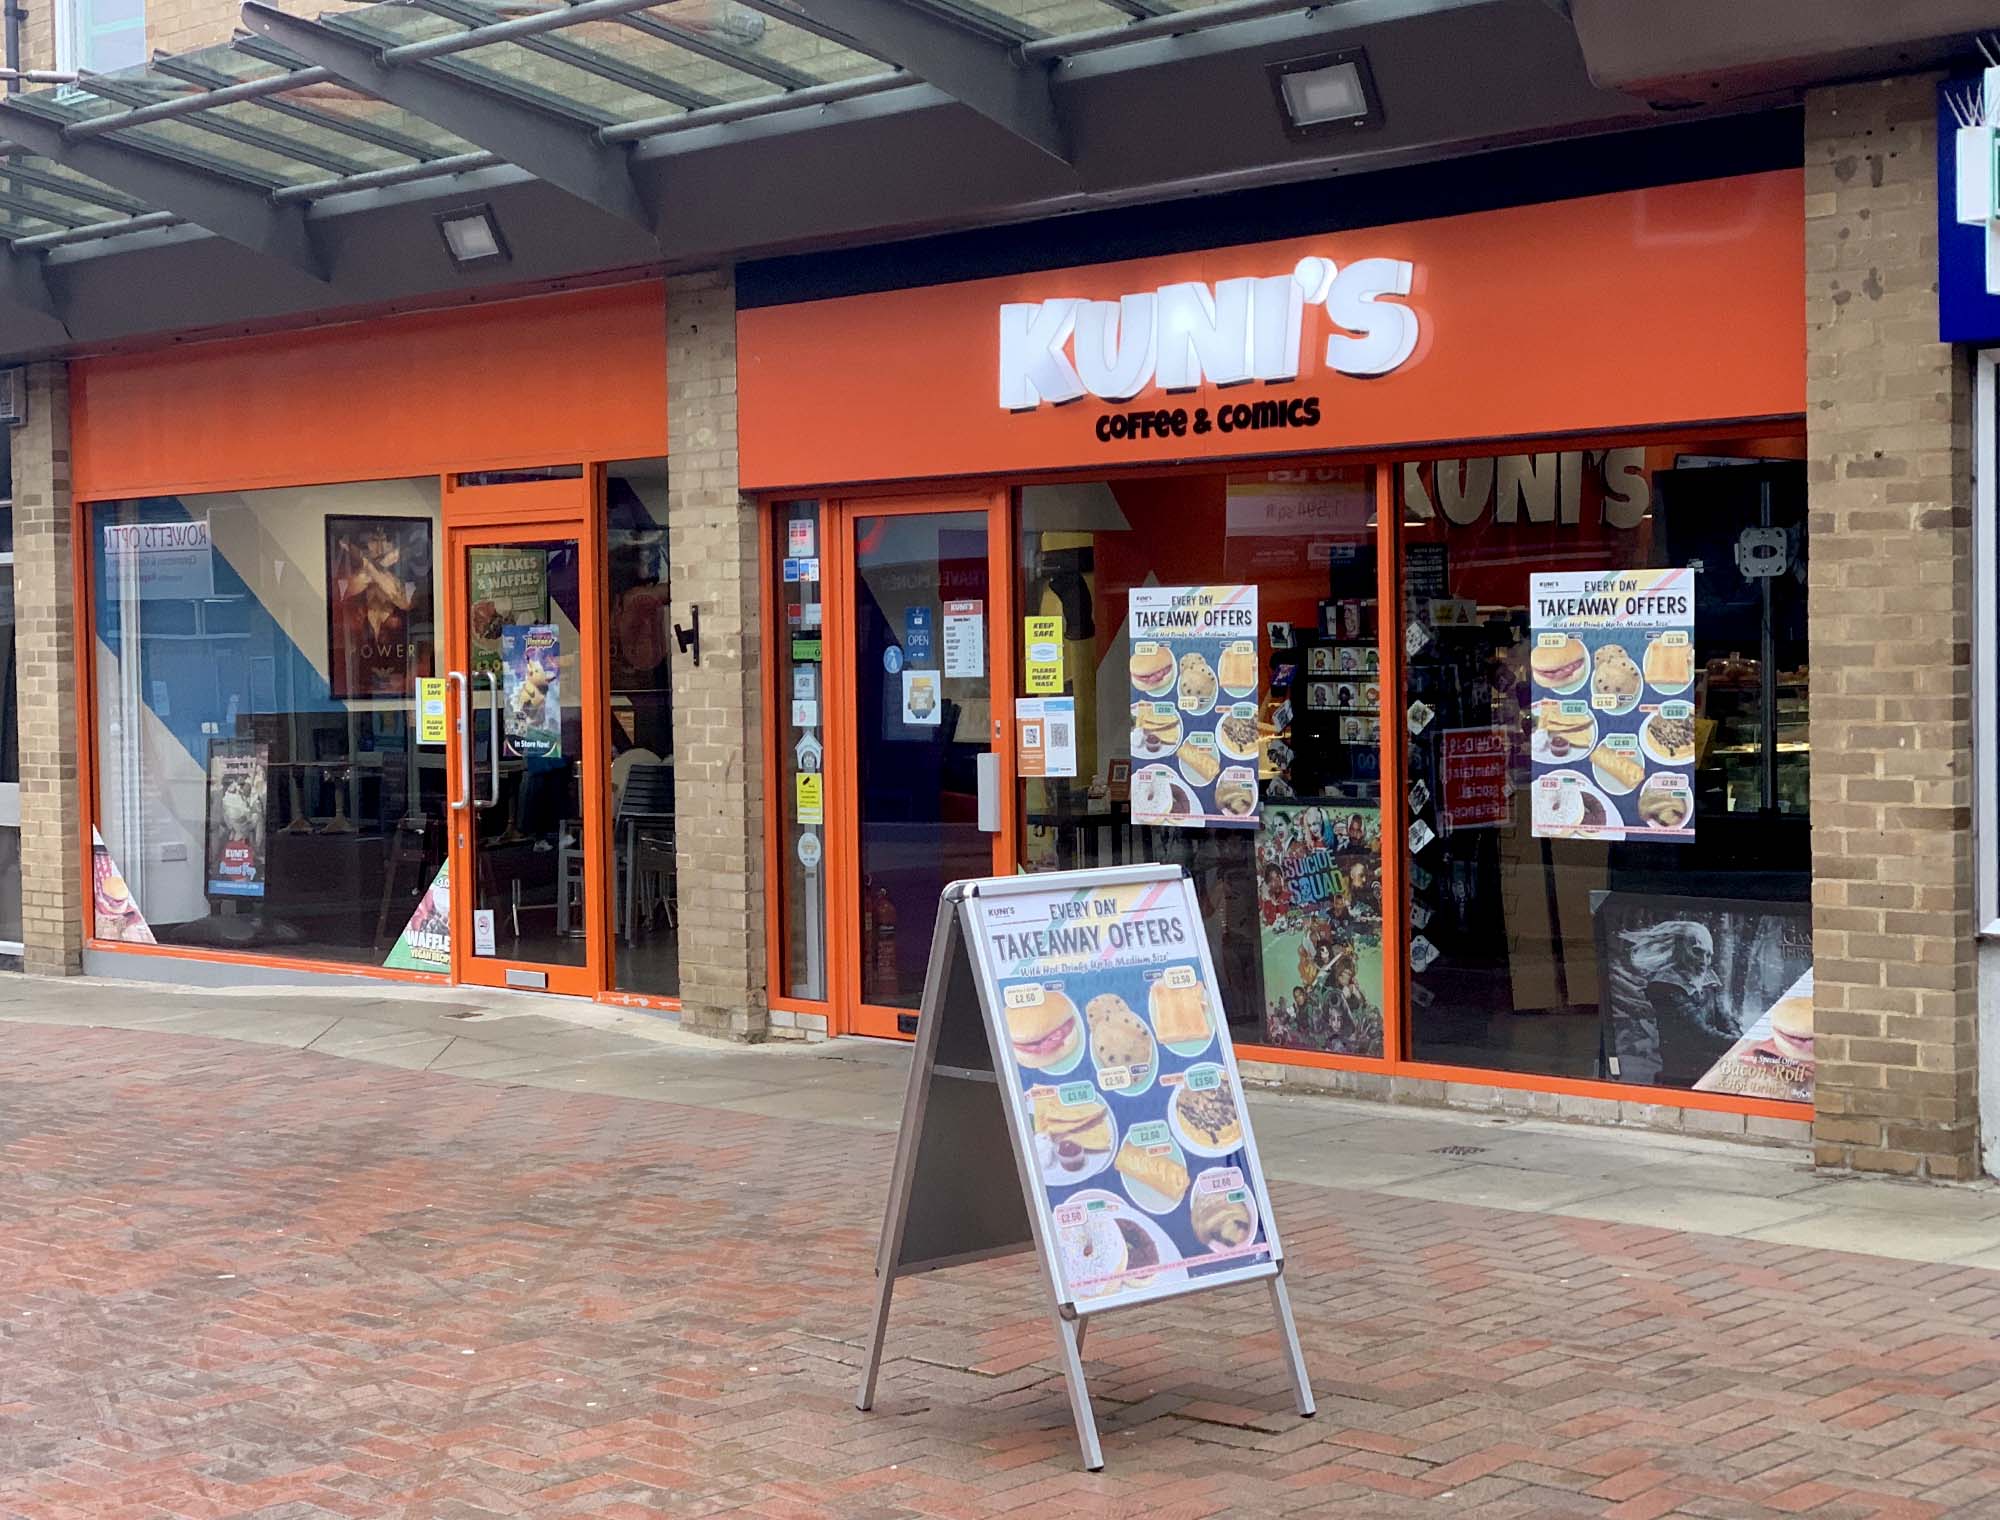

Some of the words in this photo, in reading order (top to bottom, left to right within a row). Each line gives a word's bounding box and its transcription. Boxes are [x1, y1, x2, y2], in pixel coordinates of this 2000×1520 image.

[1000, 256, 1419, 410] KUNI'S
[1193, 408, 1211, 434] &
[476, 557, 537, 574] PANCAKES
[478, 578, 487, 591] &
[488, 572, 540, 589] WAFFLES
[1584, 581, 1615, 592] EVERY
[1619, 580, 1637, 591] DAY
[1171, 596, 1196, 606] EVERY
[1199, 595, 1214, 605] DAY
[1538, 597, 1618, 617] TAKEAWAY
[1626, 596, 1687, 615] OFFERS
[1032, 622, 1054, 630] KEEP
[1135, 610, 1199, 627] TAKEAWAY
[1204, 609, 1252, 626] OFFERS
[908, 635, 929, 646] OPEN
[1033, 630, 1054, 638] SAFE
[521, 739, 535, 748] Store
[1283, 849, 1337, 880] SUICIDE
[1288, 869, 1343, 902] SQUAD
[988, 905, 1015, 916] KUNI'S
[1049, 901, 1090, 920] EVERY
[1094, 898, 1118, 915] DAY
[992, 925, 1101, 961] TAKEAWAY
[1108, 916, 1185, 949] OFFERS
[1043, 964, 1059, 976] Hot
[1115, 956, 1149, 967] Medium
[1720, 1059, 1767, 1078] Bacon
[1772, 1064, 1807, 1083] Roll
[1105, 1075, 1124, 1086] £2.50
